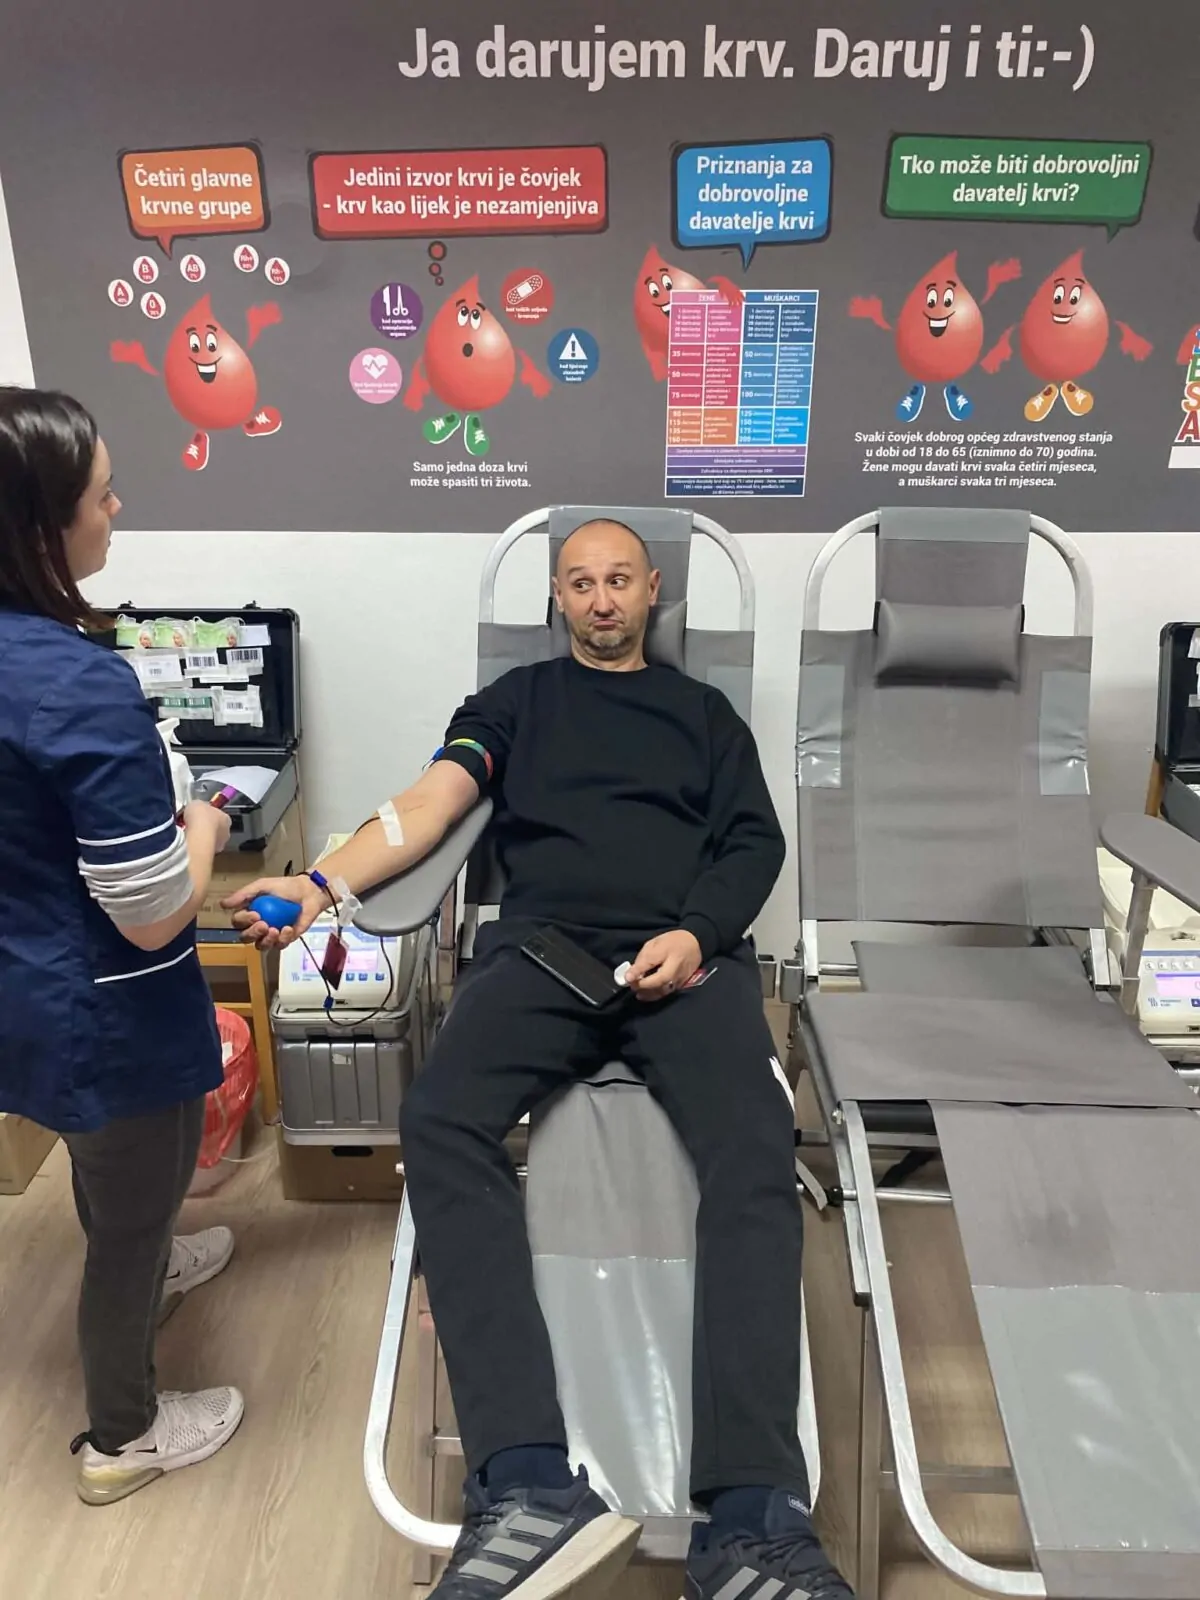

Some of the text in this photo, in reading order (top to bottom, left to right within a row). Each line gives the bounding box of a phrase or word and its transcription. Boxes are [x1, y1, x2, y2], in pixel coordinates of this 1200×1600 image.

[398, 27, 460, 78] Ja
[476, 25, 686, 92] darujem
[703, 25, 794, 78] krv.
[814, 25, 951, 92] Daruj
[965, 25, 982, 78] i
[697, 154, 813, 179] Priznanja za
[900, 154, 1140, 178] Tko može biti dobrovoljni
[134, 164, 253, 192] Četiri glavne
[343, 167, 581, 191] Jedini izvor krvi je čovjek
[698, 183, 808, 207] dobrovoljne
[952, 182, 1080, 207] davatelj krvi?
[140, 195, 252, 220] krvne grupe
[336, 195, 367, 214] krv
[371, 195, 406, 214] kao
[410, 195, 450, 219] lijek
[453, 195, 471, 219] je
[476, 195, 598, 219] nezamjenjiva
[689, 209, 814, 234] davatelje krvi
[142, 264, 149, 273] B
[187, 264, 199, 272] AB
[118, 287, 124, 297] A
[764, 294, 800, 302] MUŠKARCI
[854, 431, 1113, 446] Svaki čovjek dobrog općeg zdravstvenog stanja
[865, 446, 1098, 460] u dobi od 18 do 65 (iznimno do 70) godina.
[412, 460, 528, 475] Samo jedna doza krvi
[861, 460, 1097, 475] Žene mogu davati krvi svaka četiri mjeseca,
[410, 476, 532, 489] može spasiti tri života.
[898, 476, 1057, 490] a muškarci svaka tri mjeseca.
